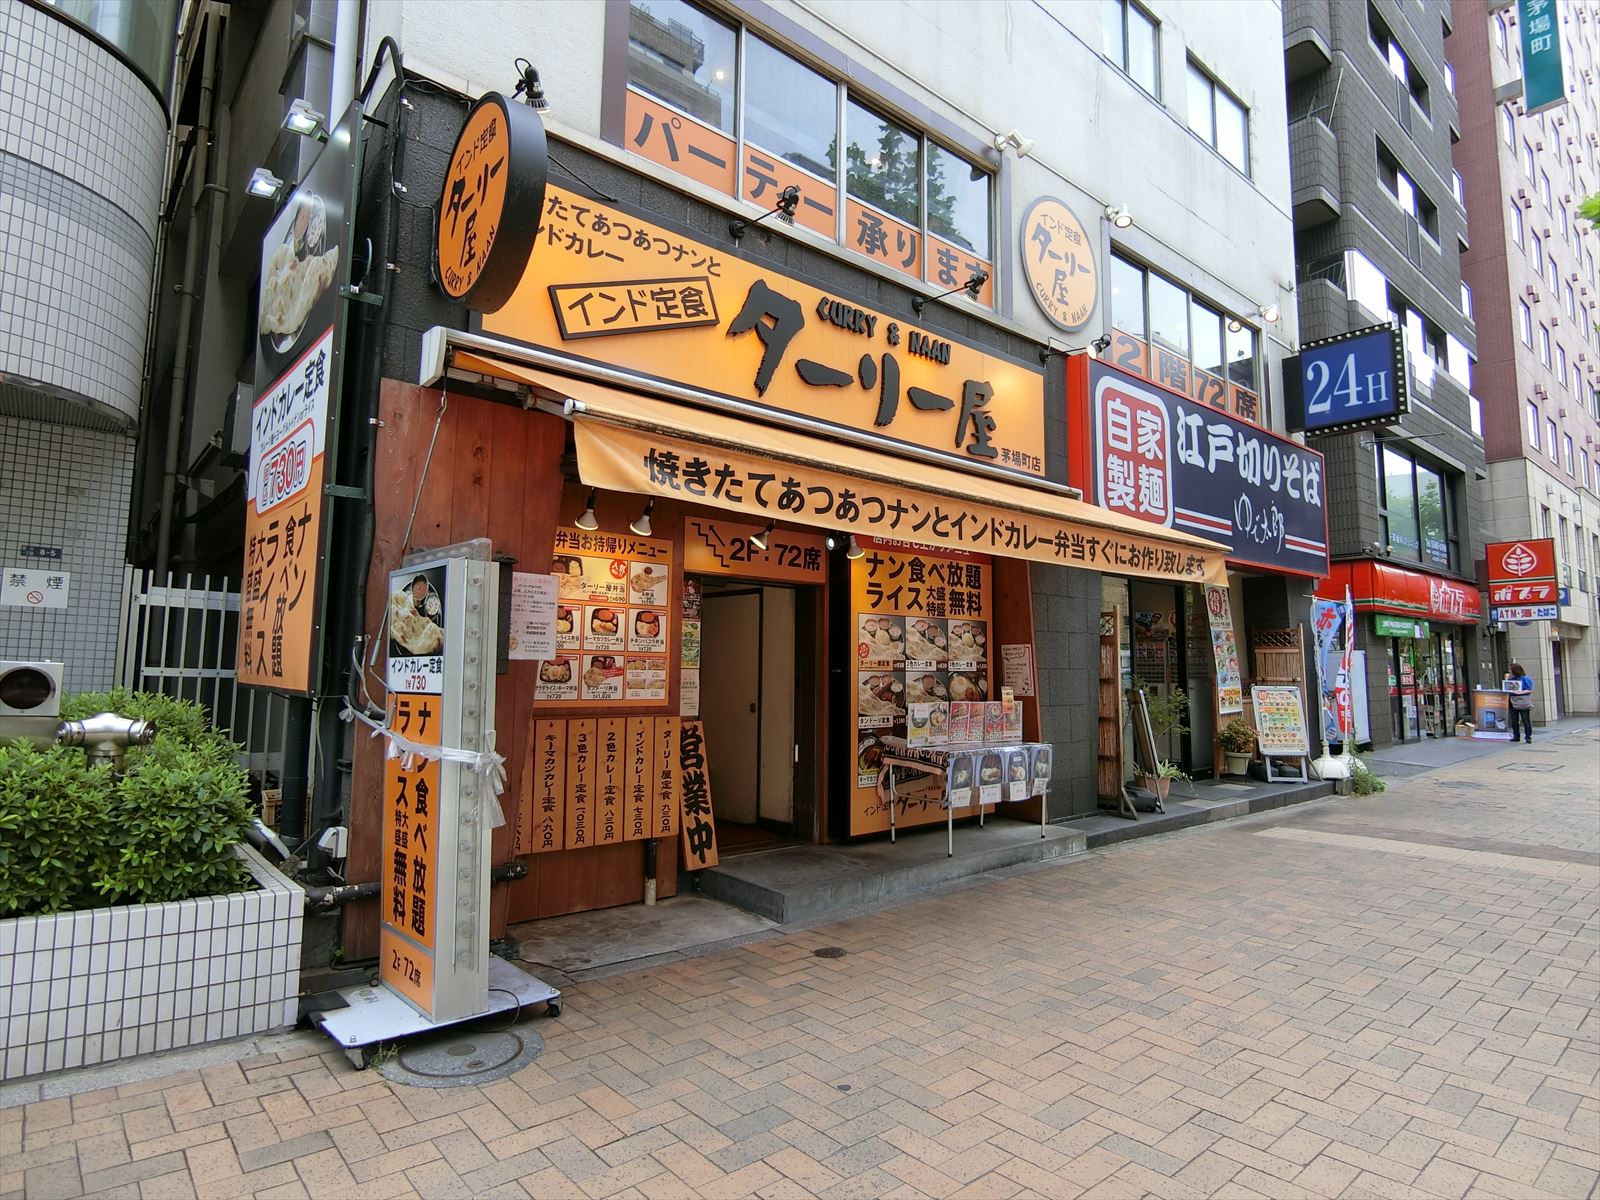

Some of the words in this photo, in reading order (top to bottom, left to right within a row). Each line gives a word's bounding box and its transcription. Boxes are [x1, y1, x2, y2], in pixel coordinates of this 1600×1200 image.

[1527, 0, 1552, 55] 茅場町
[456, 118, 497, 174] インド定食
[445, 156, 505, 240] ターリー
[1040, 213, 1082, 247] インド定食
[444, 265, 464, 293] CURRY
[475, 225, 495, 273] NAAN
[459, 208, 478, 269] 屋
[537, 223, 625, 263] ドカレー
[543, 195, 722, 279] たてあつあつナンと
[1031, 222, 1091, 277] ターリー
[568, 285, 709, 326] インド定食
[1036, 281, 1059, 316] CURRY
[1062, 311, 1068, 322] &
[1071, 303, 1090, 324] NAAN
[1052, 267, 1069, 307] 屋
[815, 296, 878, 340] CURRY
[887, 322, 901, 347] &
[908, 330, 952, 366] NAAN
[255, 348, 327, 442] インドカレー定食
[725, 278, 1000, 460] ターリー屋
[1306, 352, 1389, 415] 24H
[1000, 447, 1042, 472] 茅場町店
[1106, 398, 1163, 461] 自家
[1176, 405, 1323, 508] 江戸切りそば
[642, 447, 1206, 577] 焼きたてあつあつナンとインドカレー弁当すぐにお作り致します
[1106, 453, 1166, 517] 製麺
[288, 501, 312, 612] ナン
[555, 530, 668, 558] 弁当お持帰りメニュー
[865, 552, 982, 590] ナン食べ放題
[256, 519, 280, 677] ライス
[271, 514, 297, 678] 食べ放題
[866, 582, 924, 611] ライス
[926, 585, 946, 601] 大盛
[926, 600, 946, 617] 特盛
[948, 588, 982, 617] 無料
[1493, 584, 1551, 602] ポプラ
[391, 657, 443, 674] インドカレー定食
[395, 701, 411, 809] ラス
[541, 734, 557, 813] キーマカツカレー定食
[575, 733, 588, 804] 3色カレー定食
[604, 731, 617, 806] 2色カレー定食
[633, 729, 645, 803] インドカレー定食
[660, 730, 672, 800] ターリー屋定食
[679, 725, 714, 864] 営業中
[393, 847, 407, 927] 無料
